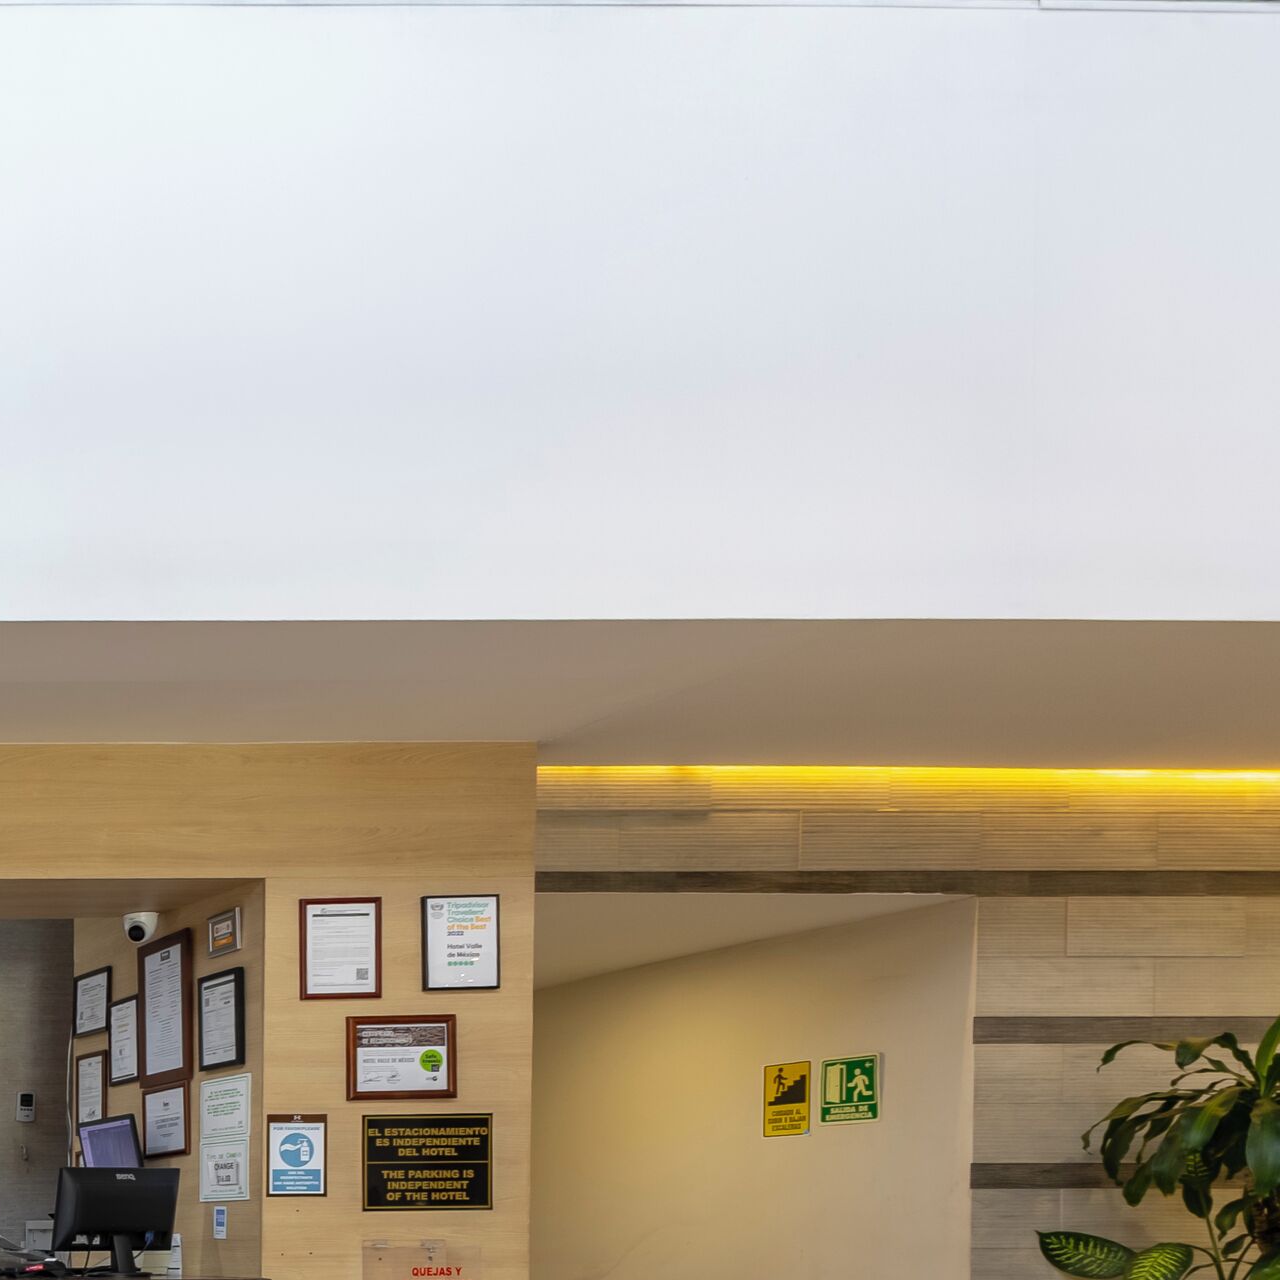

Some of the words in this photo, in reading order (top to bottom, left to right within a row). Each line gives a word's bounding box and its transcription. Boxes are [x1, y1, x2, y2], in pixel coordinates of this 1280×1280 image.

[858, 1104, 869, 1112] DE
[368, 1128, 382, 1136] EL
[384, 1127, 489, 1136] ESTACIONAMIENTO
[375, 1138, 390, 1147] ES
[392, 1137, 481, 1146] INDEPENDIENTE
[397, 1148, 420, 1156] DEL
[421, 1147, 459, 1156] HOTEL
[381, 1170, 406, 1179] THE
[407, 1169, 460, 1179] PARKING
[462, 1169, 475, 1178] IS
[386, 1180, 470, 1190] INDEPENDENT
[386, 1192, 403, 1201] OF
[404, 1192, 428, 1200] THE
[430, 1191, 470, 1200] HOTEL
[411, 1266, 452, 1277] QUEJAS
[455, 1266, 462, 1276] Y
